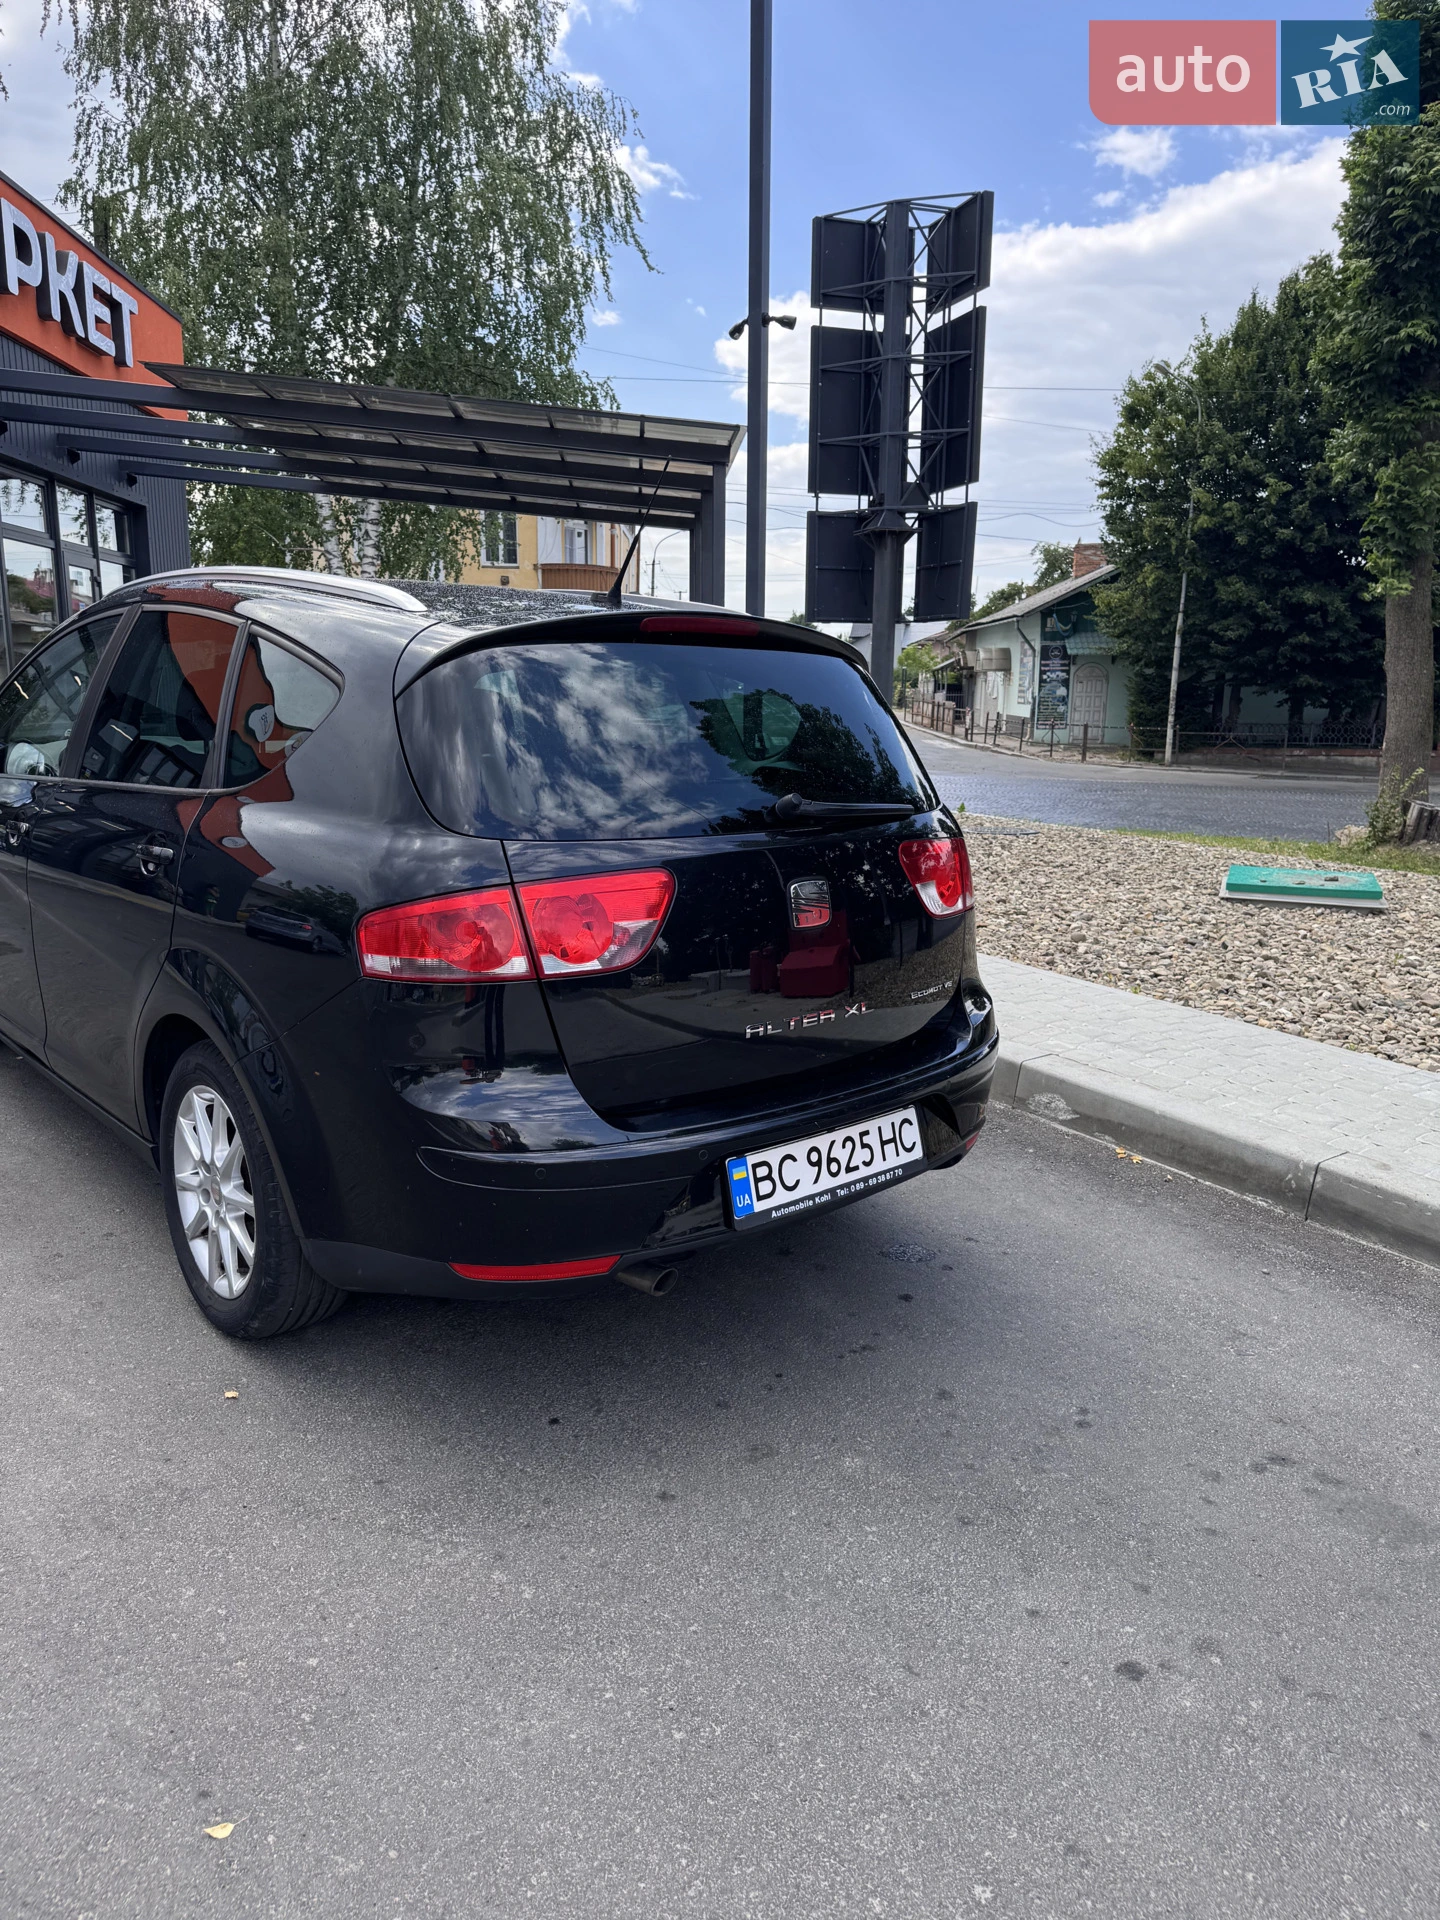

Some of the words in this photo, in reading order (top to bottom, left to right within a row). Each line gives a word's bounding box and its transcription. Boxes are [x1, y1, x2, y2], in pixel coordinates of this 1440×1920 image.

[745, 1009, 835, 1038] ALTEA
[845, 1002, 874, 1018] XL
[751, 1153, 800, 1202] BC
[806, 1130, 874, 1185] 9625
[878, 1117, 916, 1161] HC
[736, 1193, 751, 1207] UA
[771, 1199, 814, 1218] Automobile
[815, 1193, 831, 1204] Kohl
[836, 1187, 849, 1197] Tel:
